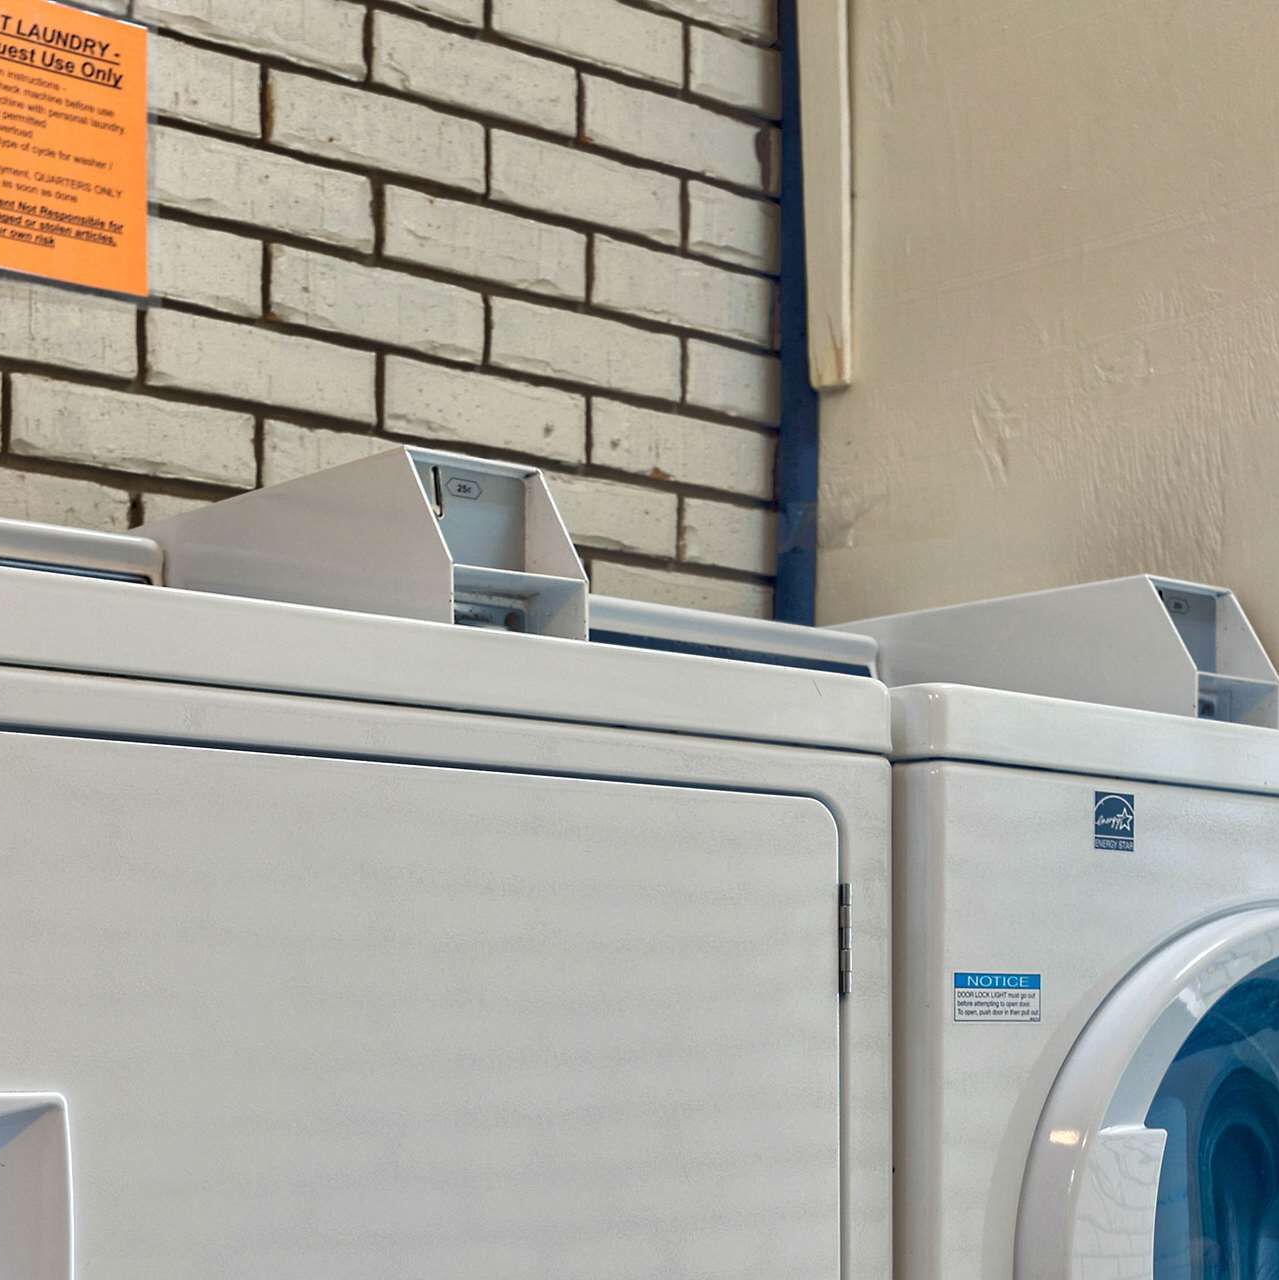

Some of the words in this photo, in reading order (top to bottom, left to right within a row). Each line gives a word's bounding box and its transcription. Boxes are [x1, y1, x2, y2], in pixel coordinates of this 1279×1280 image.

[16, 19, 109, 57] LAUNDRY
[41, 51, 75, 73] Use
[81, 62, 123, 88] Only
[23, 89, 62, 104] machine
[65, 98, 95, 113] before
[98, 107, 114, 117] use
[28, 104, 44, 114] with
[48, 109, 87, 125] personal
[90, 119, 124, 136] laundry
[20, 142, 31, 151] of
[32, 145, 56, 157] cycle
[58, 150, 71, 160] for
[73, 156, 107, 169] washer
[2, 180, 13, 188] as
[16, 183, 38, 194] soon
[41, 188, 52, 198] as
[55, 191, 77, 203] done
[34, 171, 91, 193] QUARTERS
[94, 185, 122, 198] ONLY
[18, 201, 37, 214] Not
[40, 206, 104, 230] Responsible
[108, 221, 124, 233] for
[24, 218, 37, 227] or
[39, 222, 71, 237] stolen
[10, 230, 32, 241] own
[35, 235, 54, 245] risk
[967, 975, 1028, 987] NOTICE
